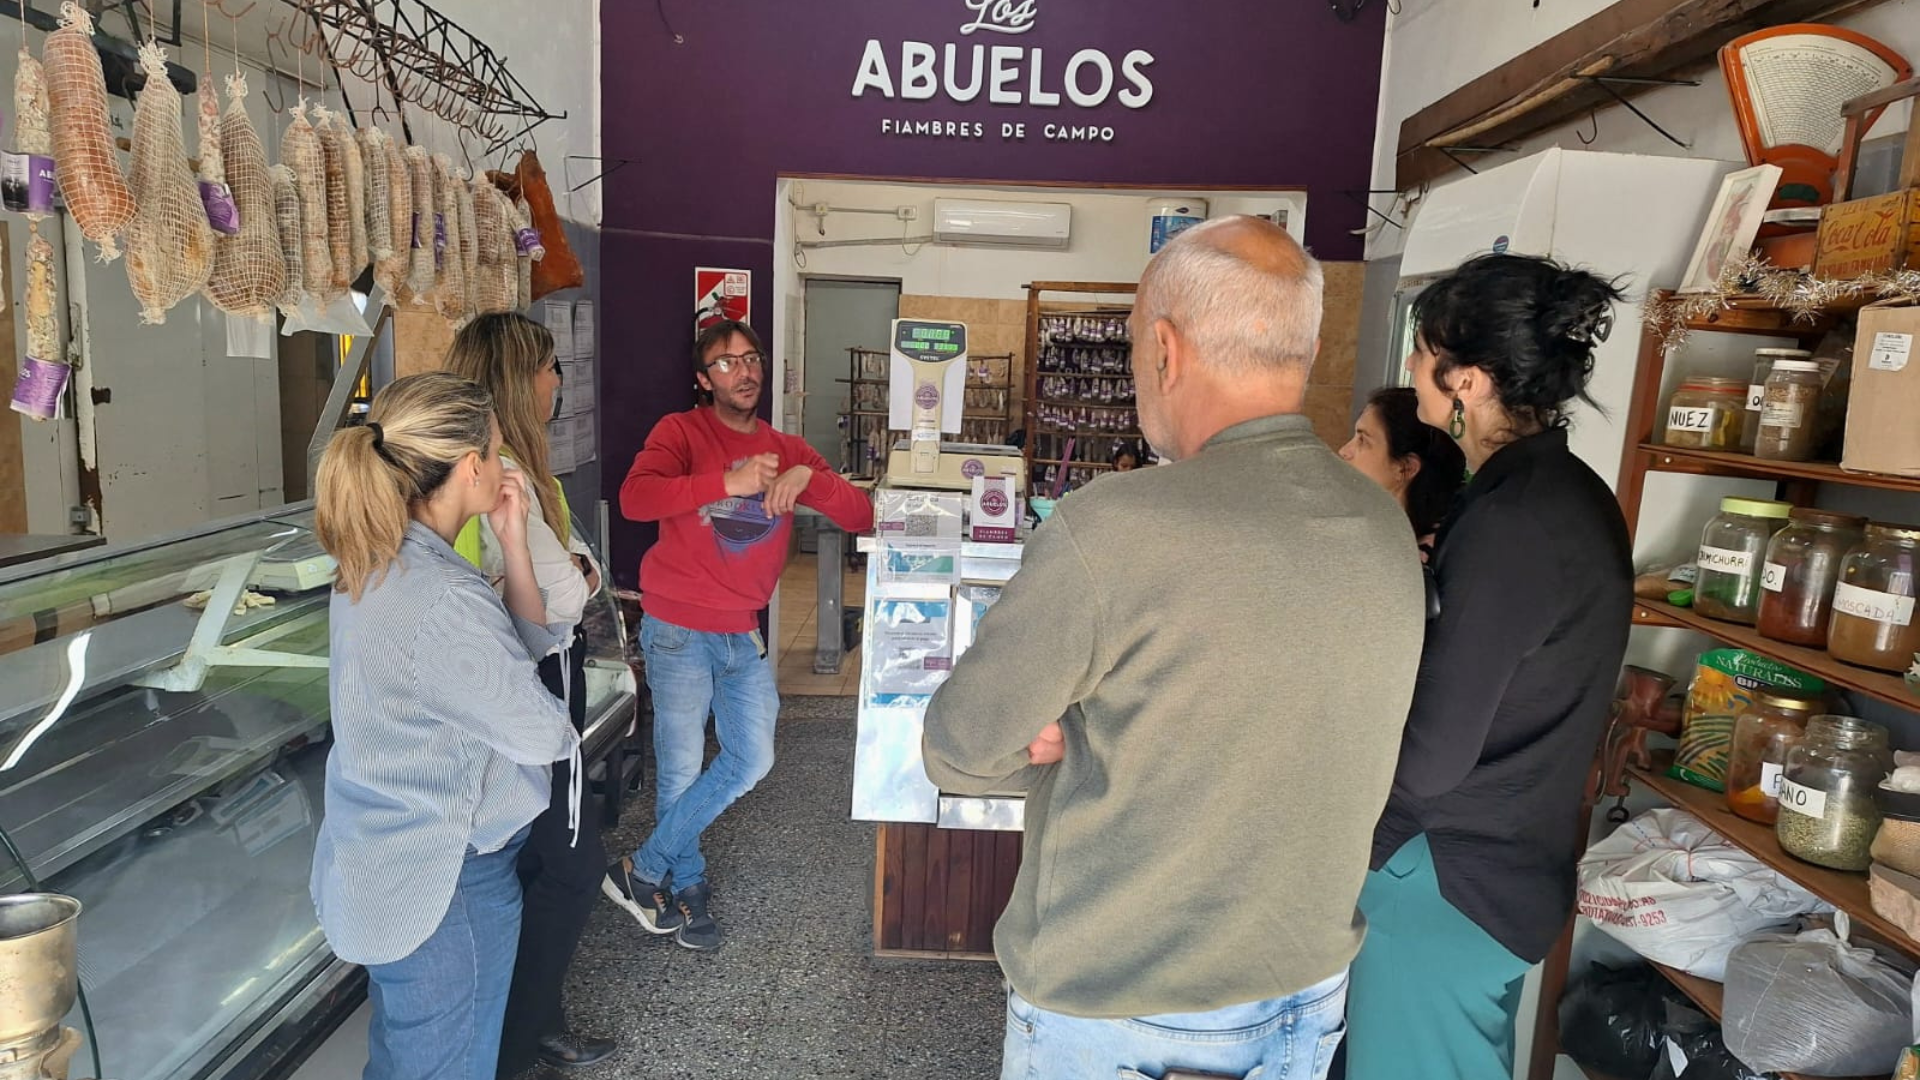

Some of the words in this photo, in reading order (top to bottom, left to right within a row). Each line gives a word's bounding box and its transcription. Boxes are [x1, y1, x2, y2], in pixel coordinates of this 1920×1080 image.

[960, 0, 1038, 34] Los
[851, 39, 1155, 108] ABUELOS
[881, 118, 984, 138] FIAMBRES
[1001, 123, 1026, 138] DE
[1044, 123, 1115, 142] CAMPO
[1669, 411, 1709, 428] NUEZ
